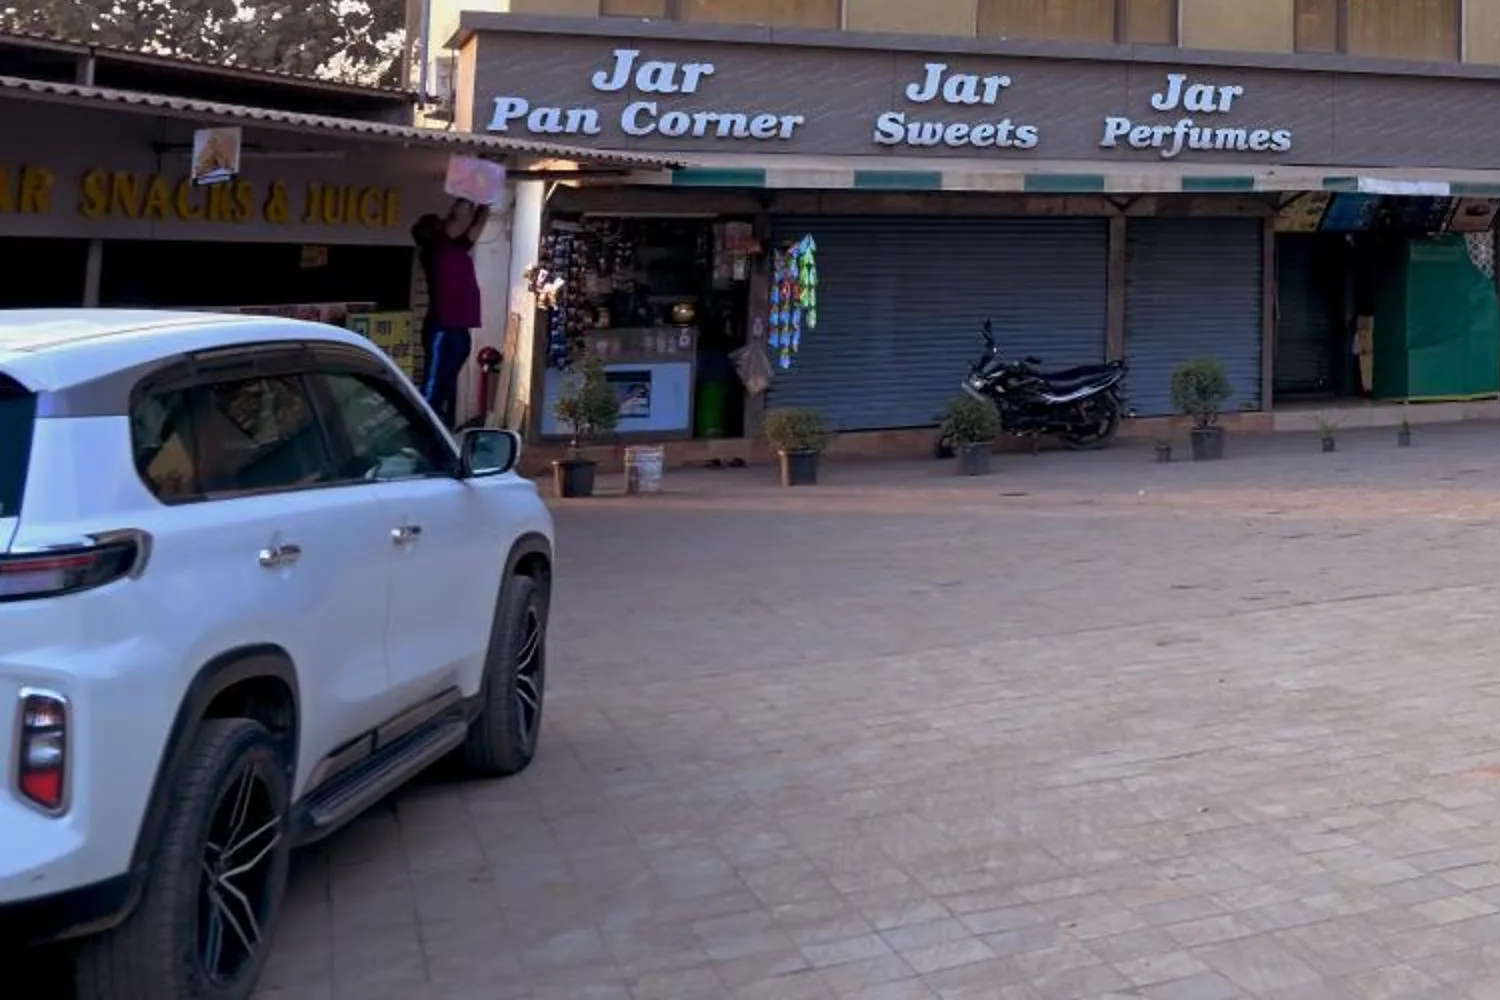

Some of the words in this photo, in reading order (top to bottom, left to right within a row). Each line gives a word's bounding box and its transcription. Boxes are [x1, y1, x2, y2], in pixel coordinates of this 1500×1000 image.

[591, 49, 716, 93] Jar
[905, 62, 1011, 105] Jar
[1151, 72, 1244, 114] Jar
[486, 96, 600, 134] Pan
[620, 101, 805, 140] Corner
[872, 111, 1040, 150] Sweets
[1100, 116, 1292, 158] Perfumes
[77, 167, 253, 222] SNACKS
[263, 179, 290, 224] &
